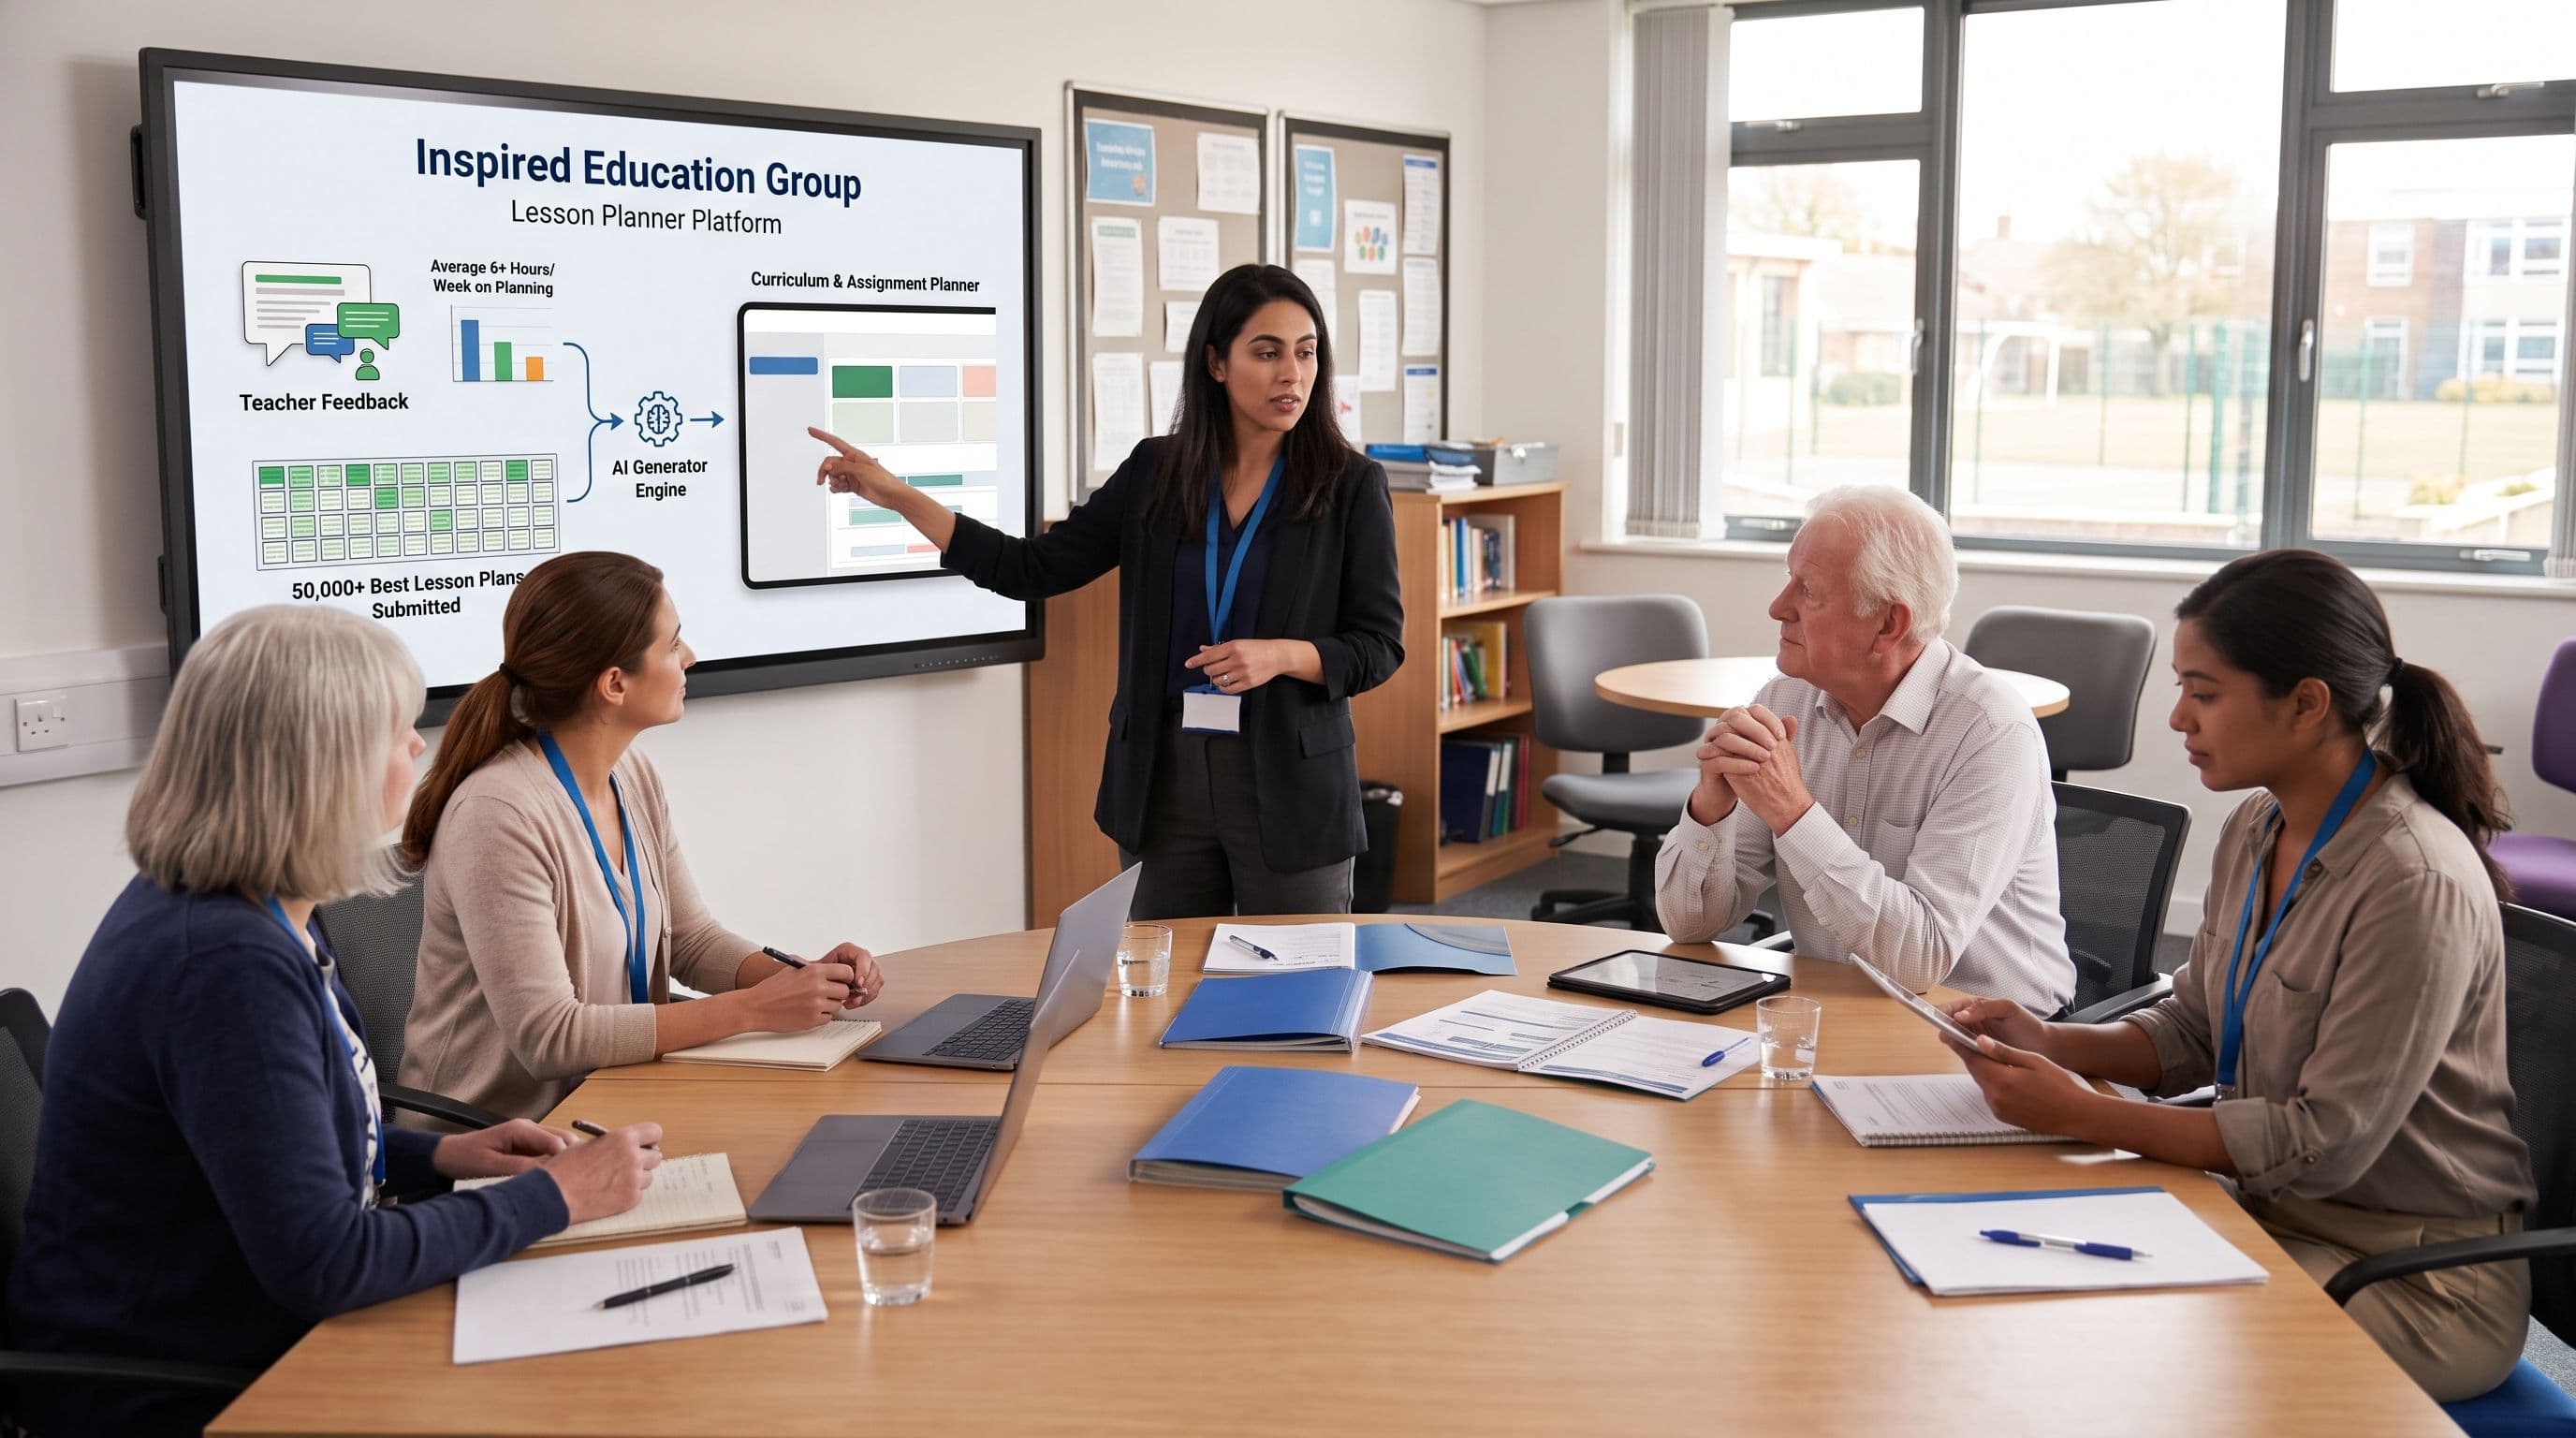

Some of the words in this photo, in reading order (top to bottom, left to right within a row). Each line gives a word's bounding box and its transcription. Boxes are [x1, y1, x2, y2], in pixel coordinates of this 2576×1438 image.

[417, 138, 571, 188] Inspired
[584, 149, 755, 194] Education
[766, 162, 862, 209] Group
[511, 198, 594, 226] Lesson
[602, 203, 686, 230] Planner
[693, 208, 782, 235] Platform
[430, 258, 487, 277] Average
[490, 260, 507, 274] 6+
[510, 261, 556, 277] Hours/
[432, 278, 472, 293] Week
[475, 283, 492, 294] on
[495, 280, 553, 299] Planning
[751, 271, 829, 288] Curriculum
[832, 273, 843, 288] &
[846, 274, 928, 293] Assignment
[930, 276, 980, 293] Planner
[239, 392, 317, 412] Teacher
[321, 391, 409, 411] Feedback
[611, 460, 628, 476] AI
[633, 459, 709, 475] Generator
[636, 481, 687, 502] Engine
[291, 579, 366, 602] 50,000+
[370, 577, 410, 594] Best
[414, 575, 475, 592] Lesson
[479, 570, 524, 587] Plans
[372, 595, 461, 620] Submitted
